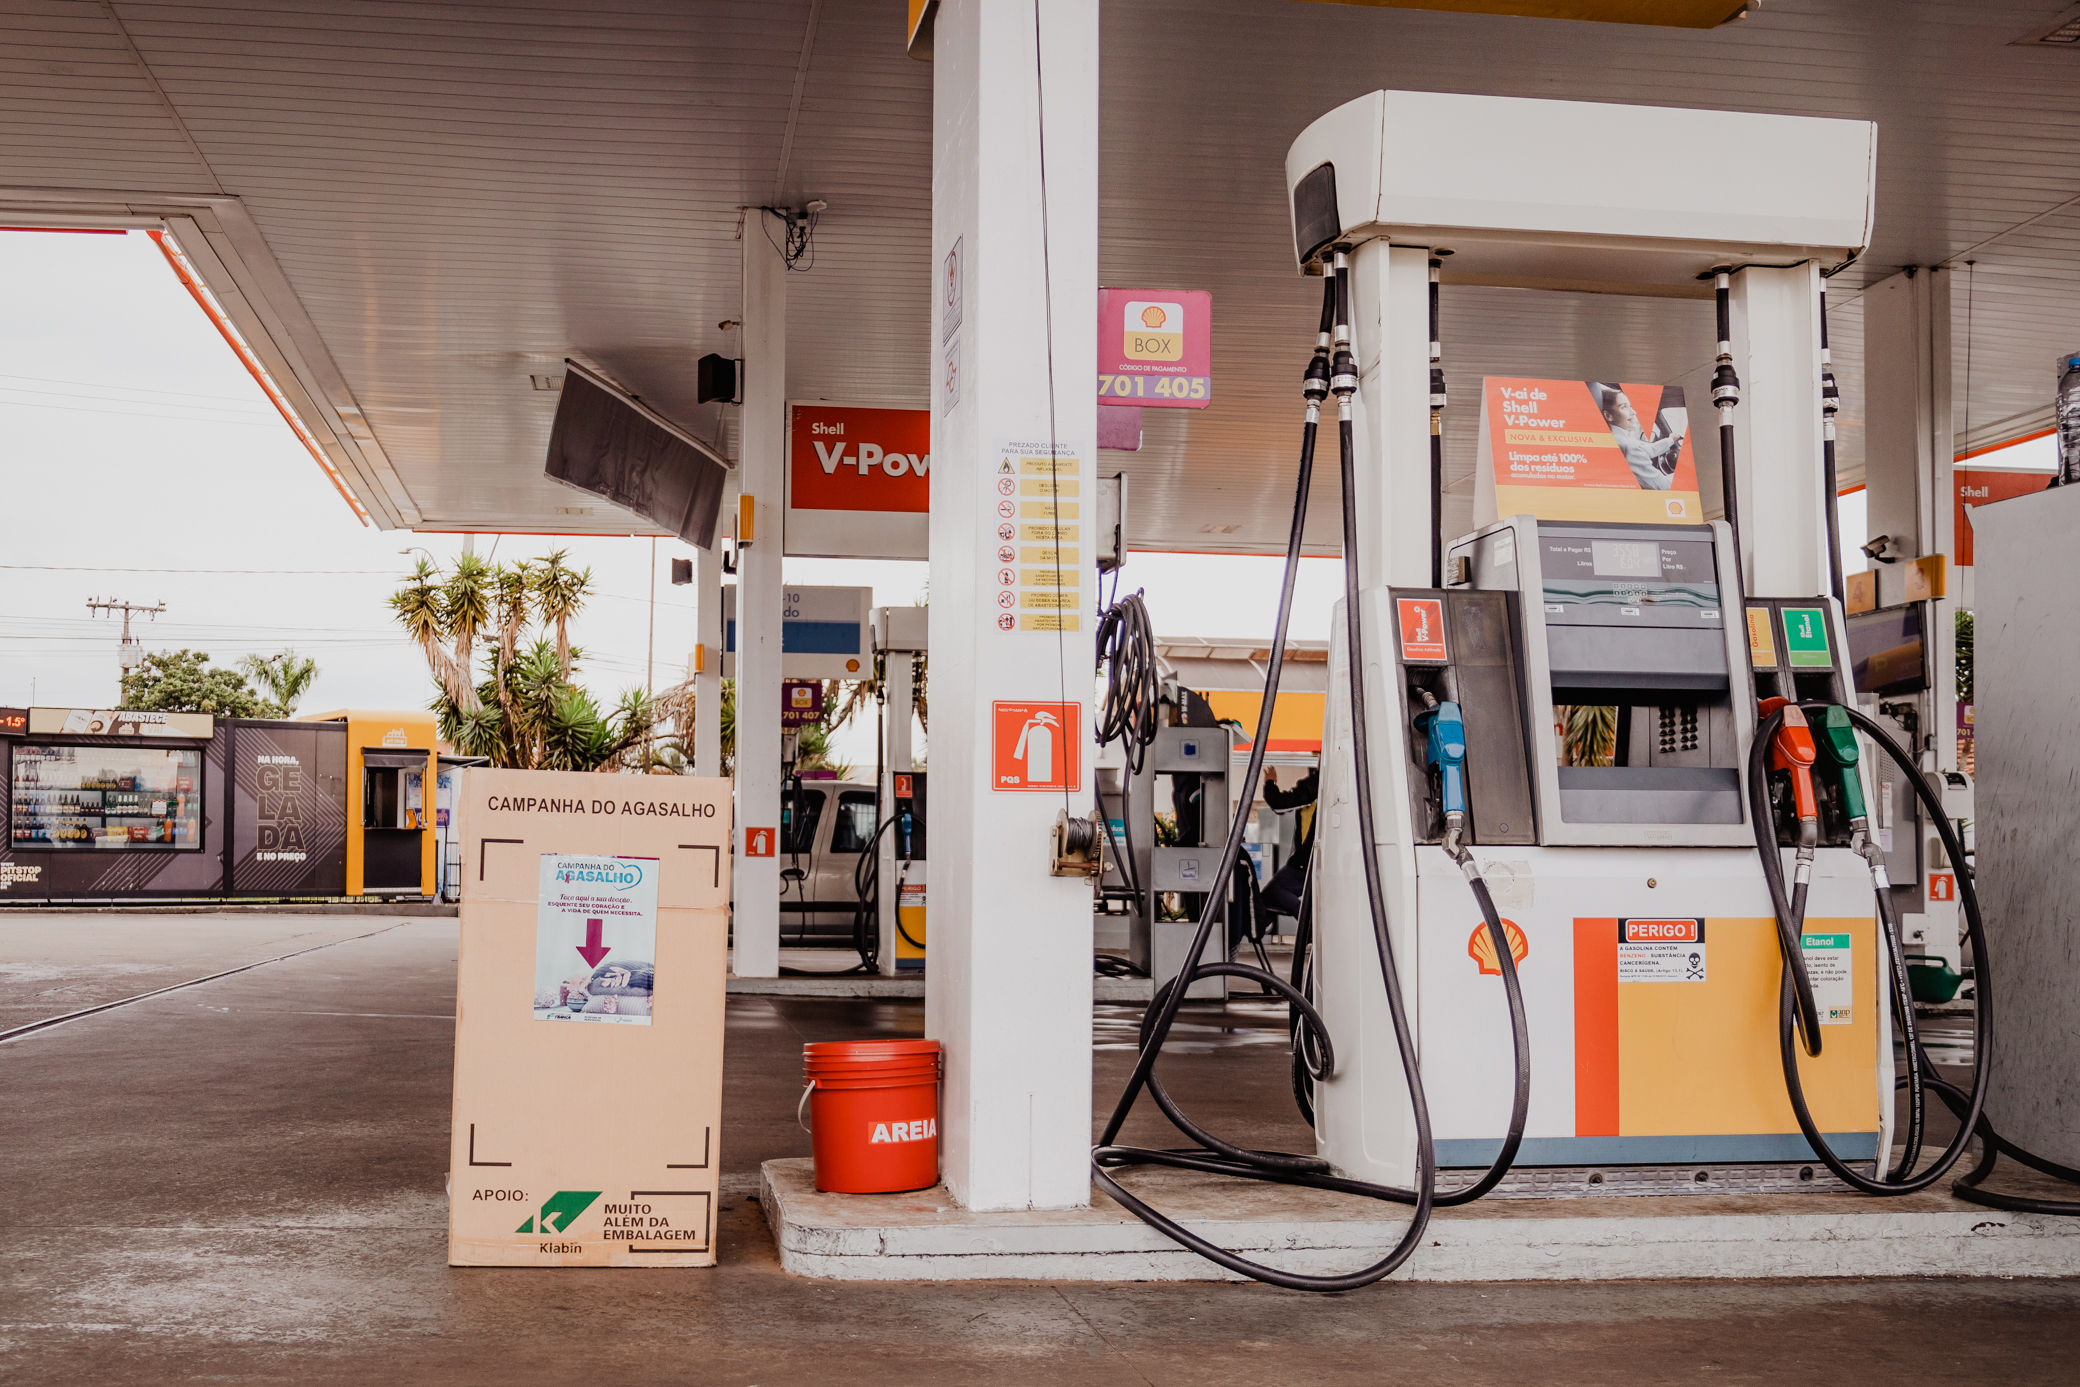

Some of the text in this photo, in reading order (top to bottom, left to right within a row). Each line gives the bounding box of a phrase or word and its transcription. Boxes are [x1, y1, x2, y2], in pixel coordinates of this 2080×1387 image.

[1134, 338, 1171, 353] BOX
[1098, 375, 1205, 398] 701 405
[1500, 387, 1547, 400] V-ai de
[1503, 401, 1537, 413] Shell
[1504, 414, 1566, 428] V-Power
[812, 422, 844, 434] Shell
[1510, 433, 1536, 441] NOVA
[1548, 434, 1594, 444] EXCLUSIVA
[1509, 451, 1587, 463] Limpa até 100%
[1510, 462, 1575, 473] dos resíduos
[1960, 486, 1988, 498] Shell
[1915, 567, 1925, 590] 3
[1852, 581, 1863, 602] 4
[1420, 609, 1429, 642] V-Power
[1749, 614, 1758, 648] Gasolina
[1801, 614, 1812, 638] Etanol
[118, 712, 168, 724] ABASTECE
[783, 711, 799, 719] 701
[1957, 728, 1970, 736] 701
[258, 755, 299, 766] NA HORA,
[1001, 776, 1020, 784] PQS
[488, 796, 716, 818] CAMPANHA DO AGASALHO
[257, 852, 307, 863] E NO PREÇO
[1, 866, 42, 874] PITSTOP
[557, 862, 601, 870] CAMPANHA
[0, 874, 39, 882] OFICIAL
[555, 870, 634, 884] AGASALHO
[1629, 924, 1694, 937] PERIGO !
[1806, 937, 1834, 946] Etanol
[871, 1118, 937, 1143] AREIA
[472, 1190, 529, 1202] APOIO:
[604, 1204, 652, 1215] MUITO
[603, 1215, 669, 1227] ALÉM DA
[603, 1230, 695, 1240] EMBALAGEM
